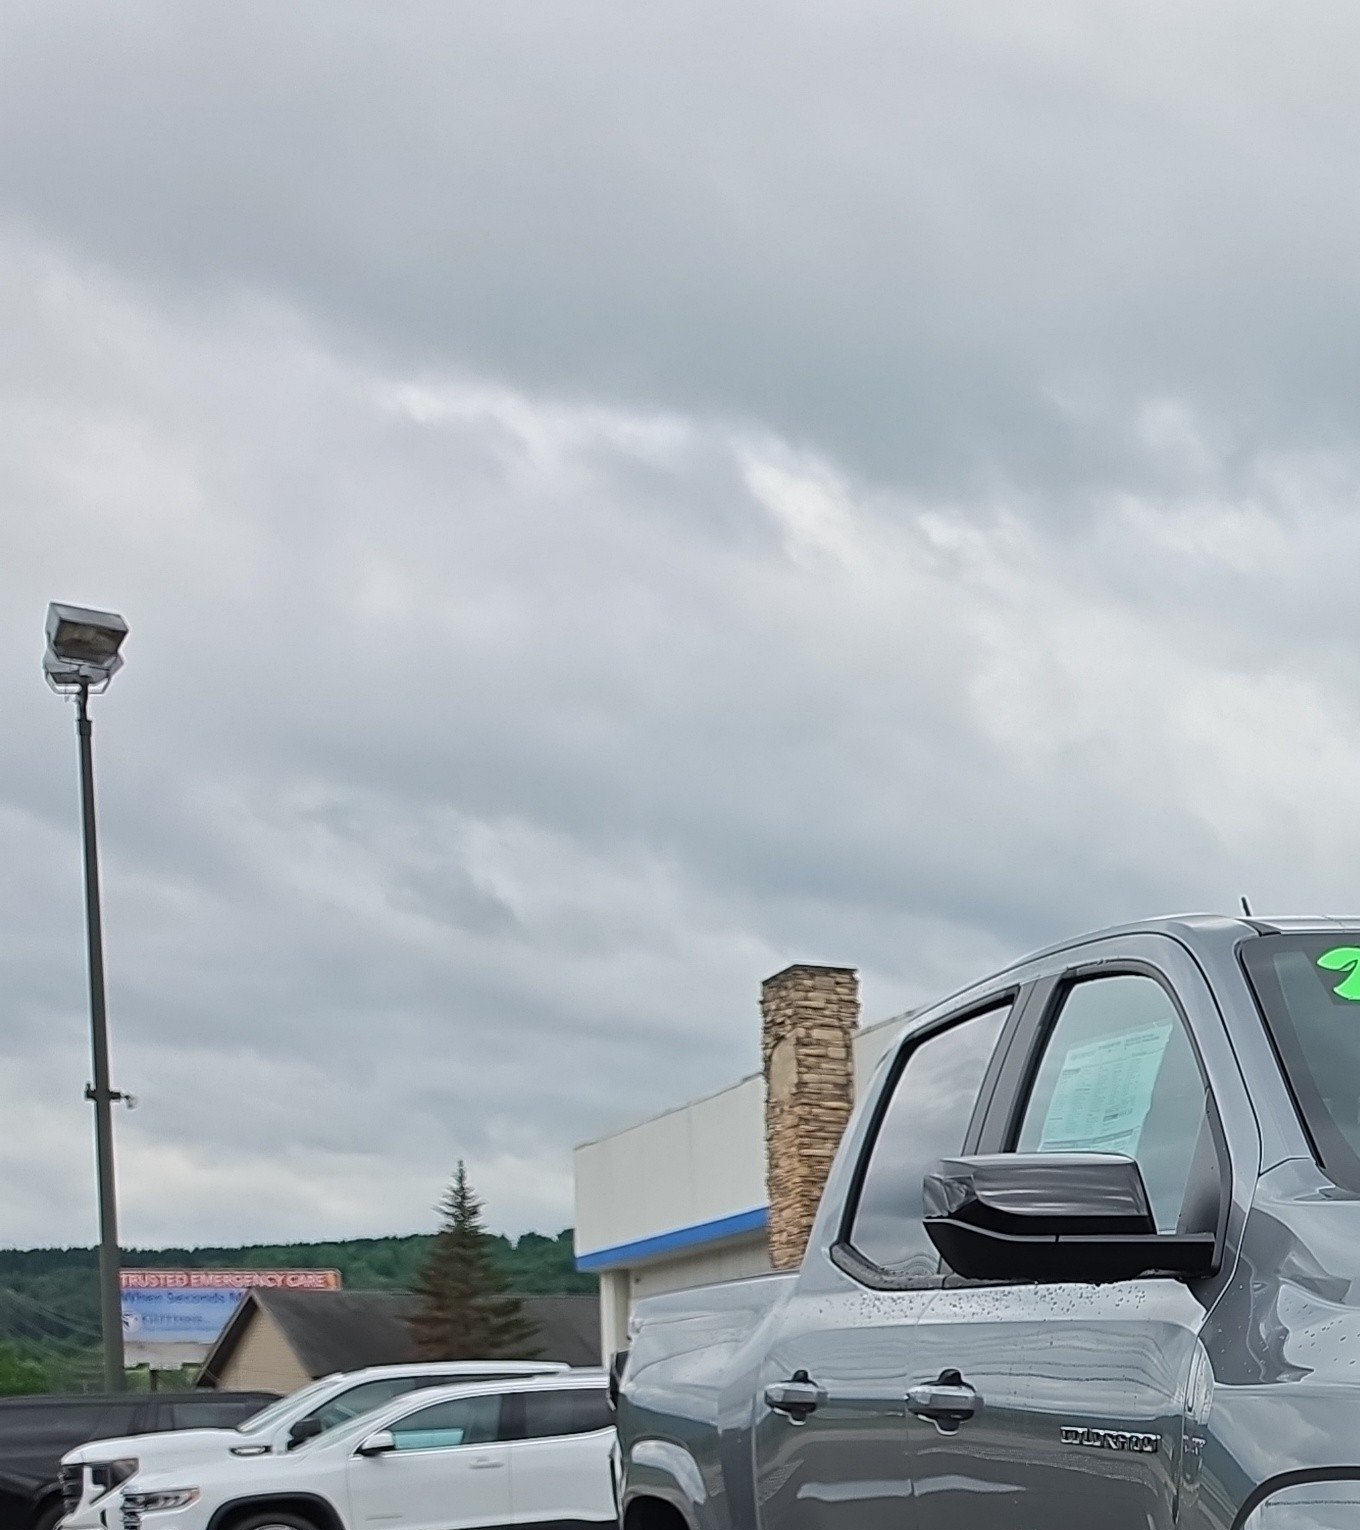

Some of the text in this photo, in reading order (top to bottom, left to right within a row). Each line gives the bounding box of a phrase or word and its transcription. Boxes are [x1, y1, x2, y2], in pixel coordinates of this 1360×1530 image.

[120, 1273, 326, 1288] TRUSTED EMERGENCY CARE
